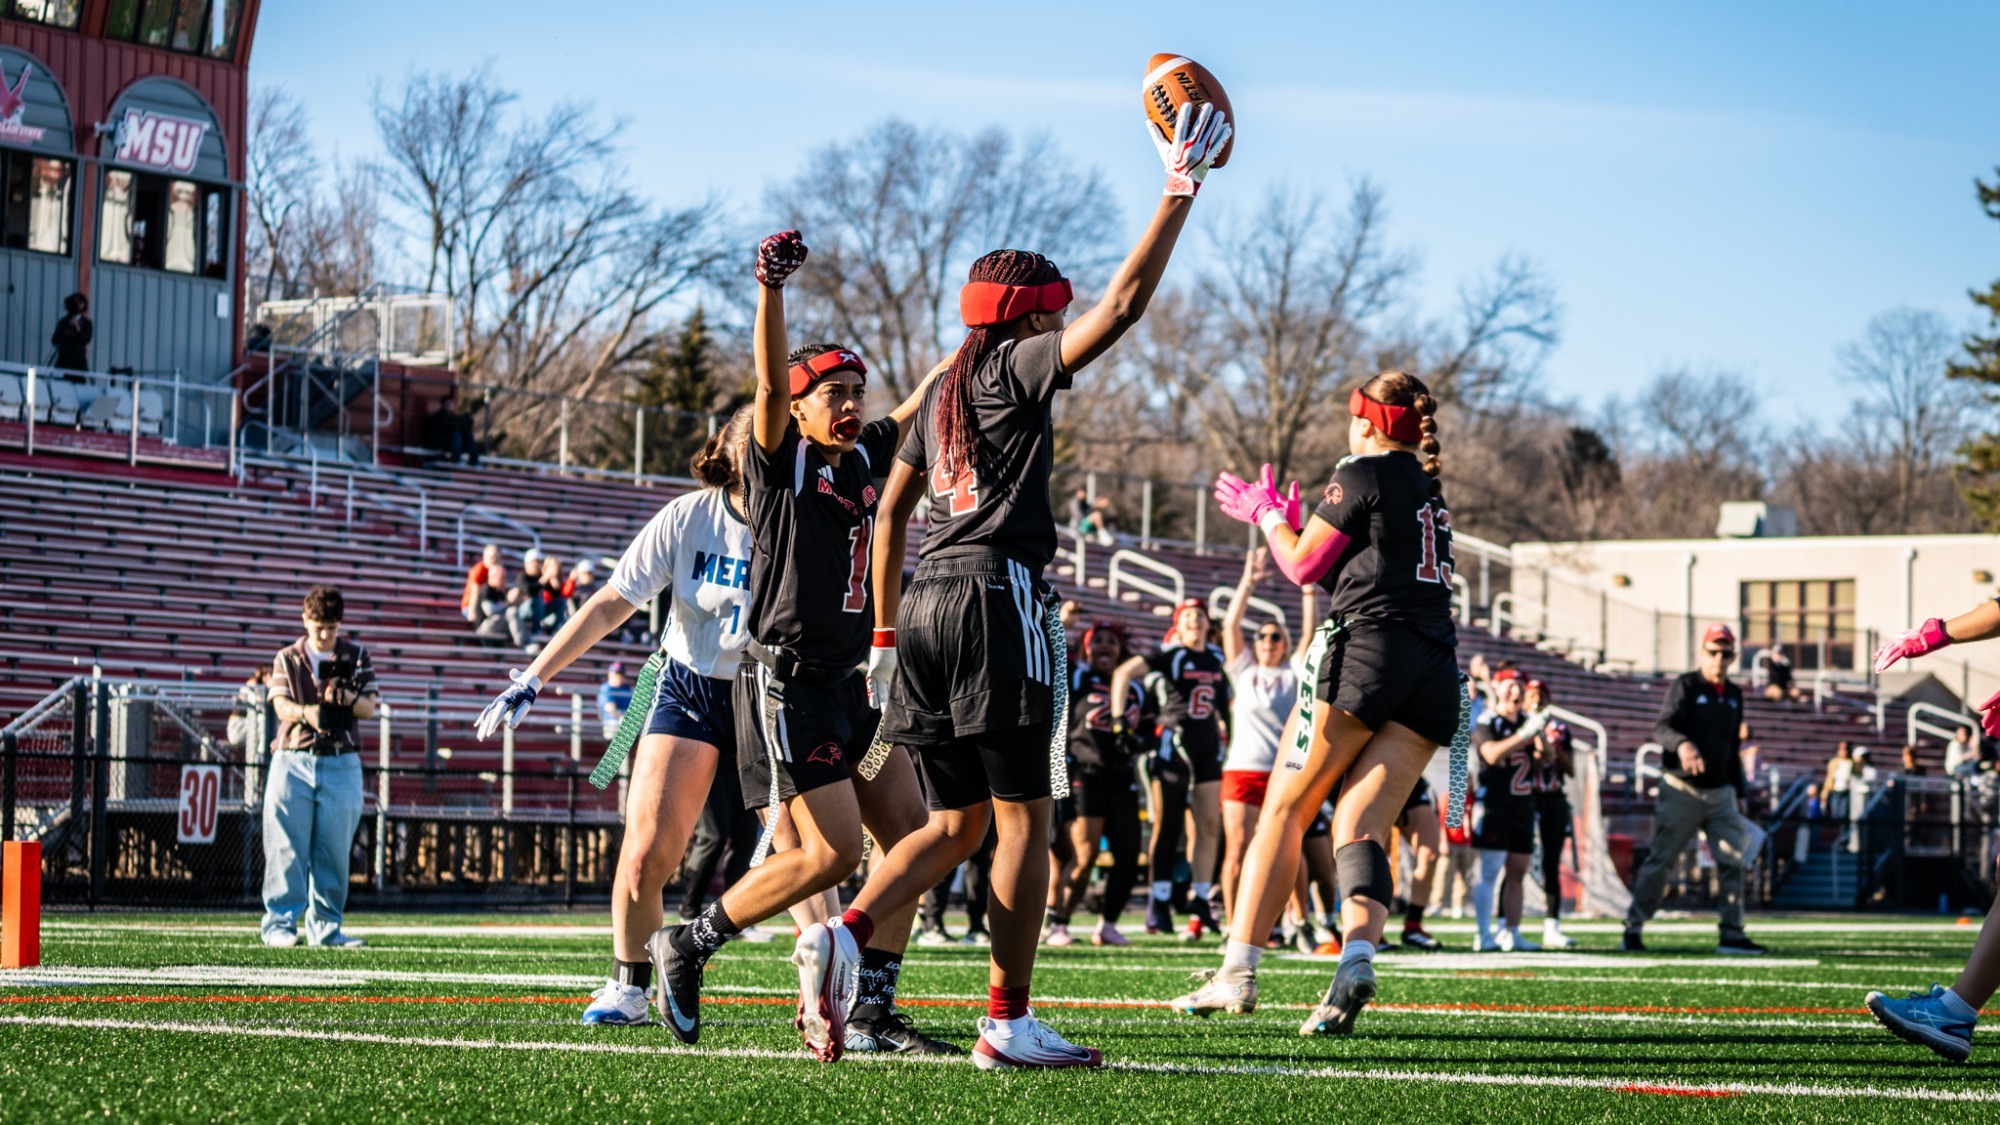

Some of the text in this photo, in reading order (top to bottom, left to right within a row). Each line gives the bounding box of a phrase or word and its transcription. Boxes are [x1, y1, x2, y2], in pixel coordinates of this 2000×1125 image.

[117, 111, 204, 172] MSU
[930, 445, 979, 518] 4
[841, 515, 876, 614] 1
[1188, 685, 1216, 720] 6
[1510, 752, 1532, 796] 2
